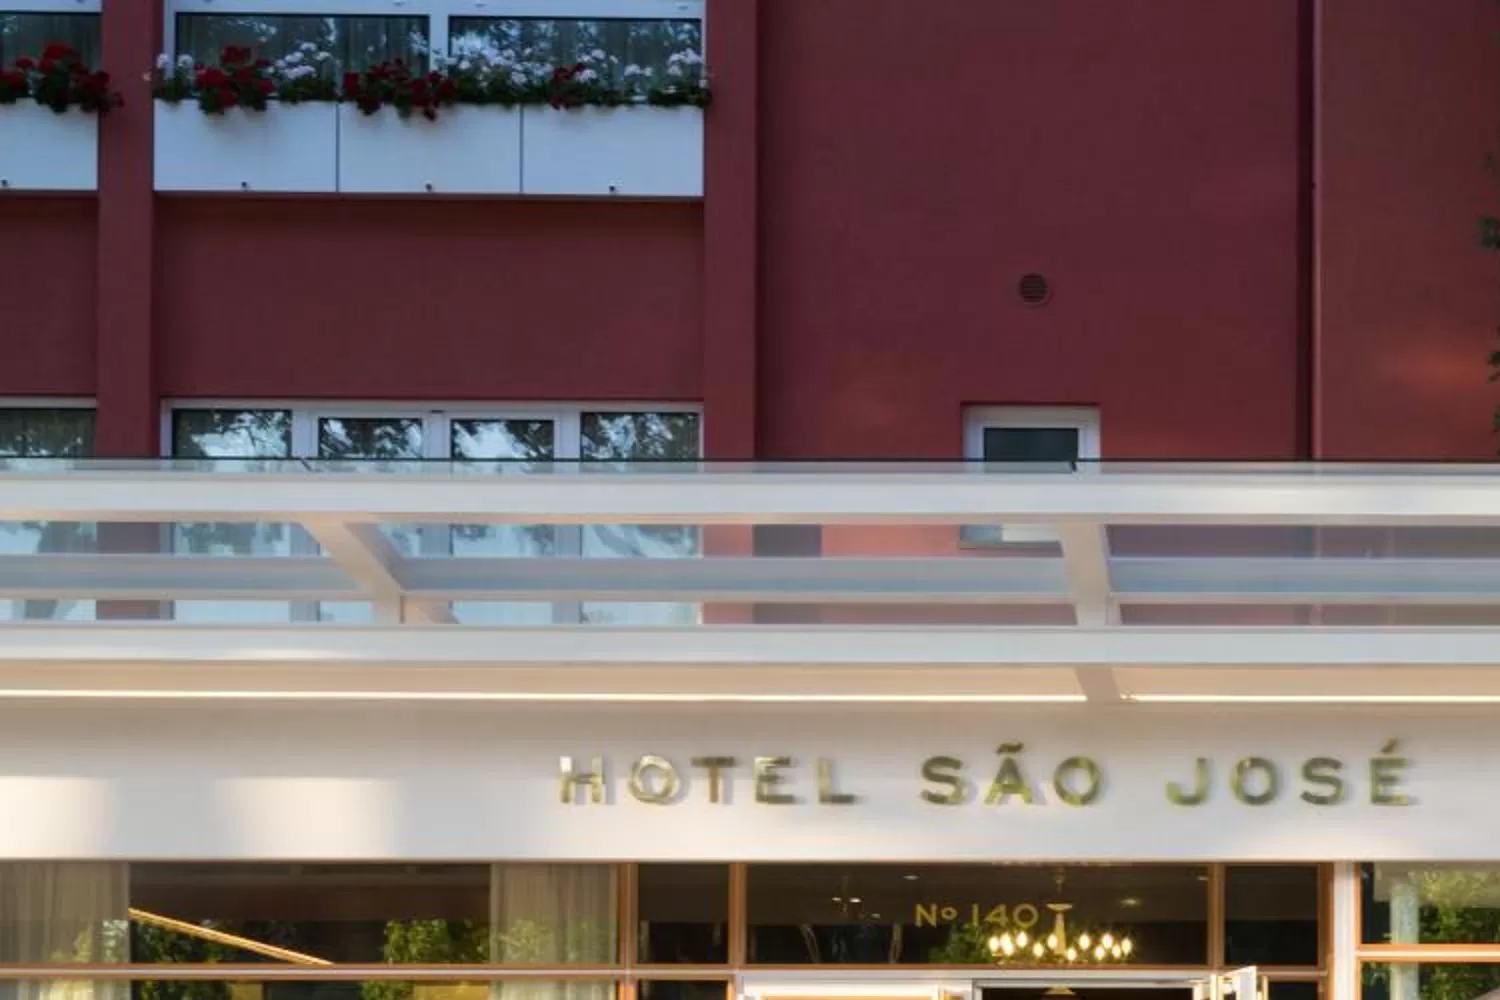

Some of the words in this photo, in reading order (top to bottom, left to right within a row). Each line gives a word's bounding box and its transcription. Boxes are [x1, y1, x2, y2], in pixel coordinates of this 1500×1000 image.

[559, 755, 856, 804] HOTEL
[920, 743, 1102, 806] SÃO
[1166, 738, 1414, 806] JOSÉ
[971, 903, 1039, 928] 140
